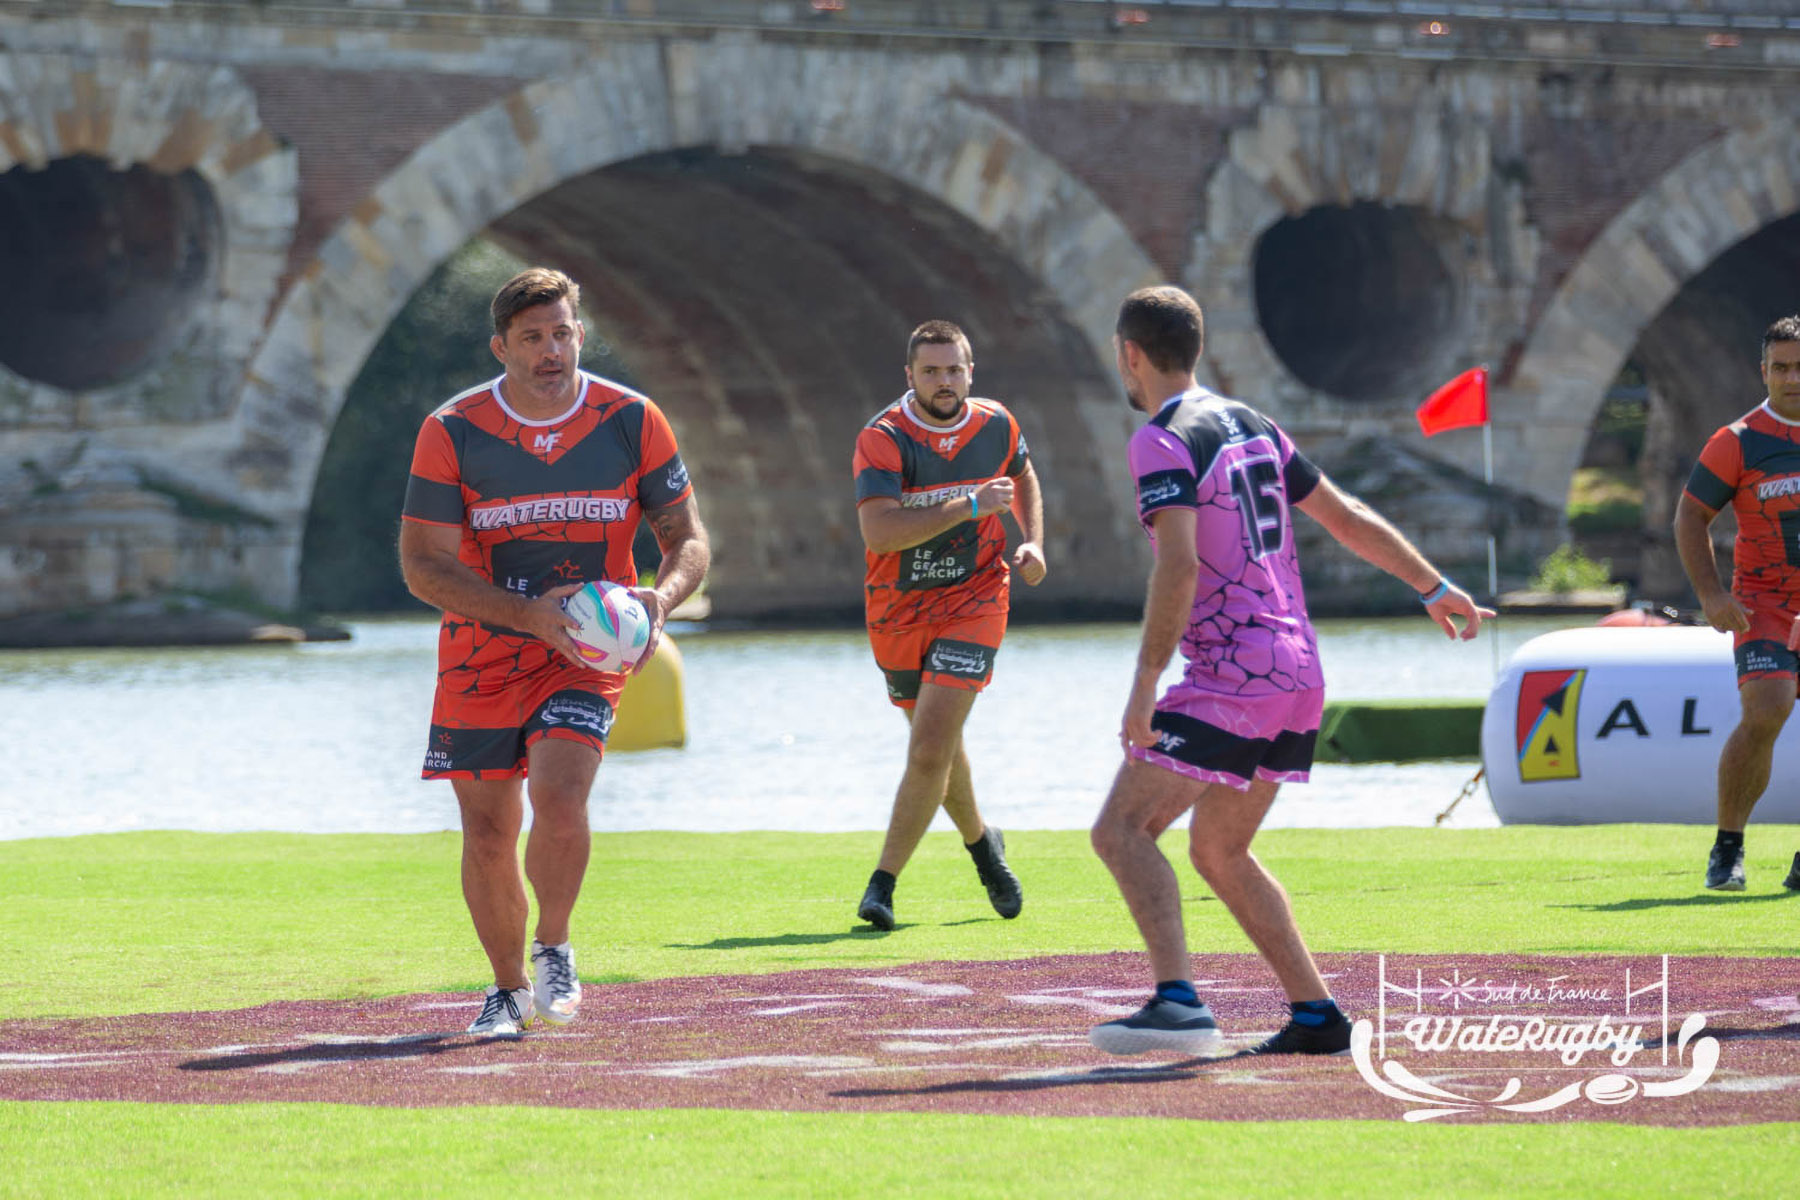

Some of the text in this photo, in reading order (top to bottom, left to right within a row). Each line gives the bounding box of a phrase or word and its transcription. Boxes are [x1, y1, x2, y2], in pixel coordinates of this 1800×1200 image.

[534, 432, 563, 452] MF
[470, 498, 629, 530] WATERUGBY
[1226, 453, 1287, 560] 15
[914, 548, 932, 560] LE
[506, 576, 528, 591] LE
